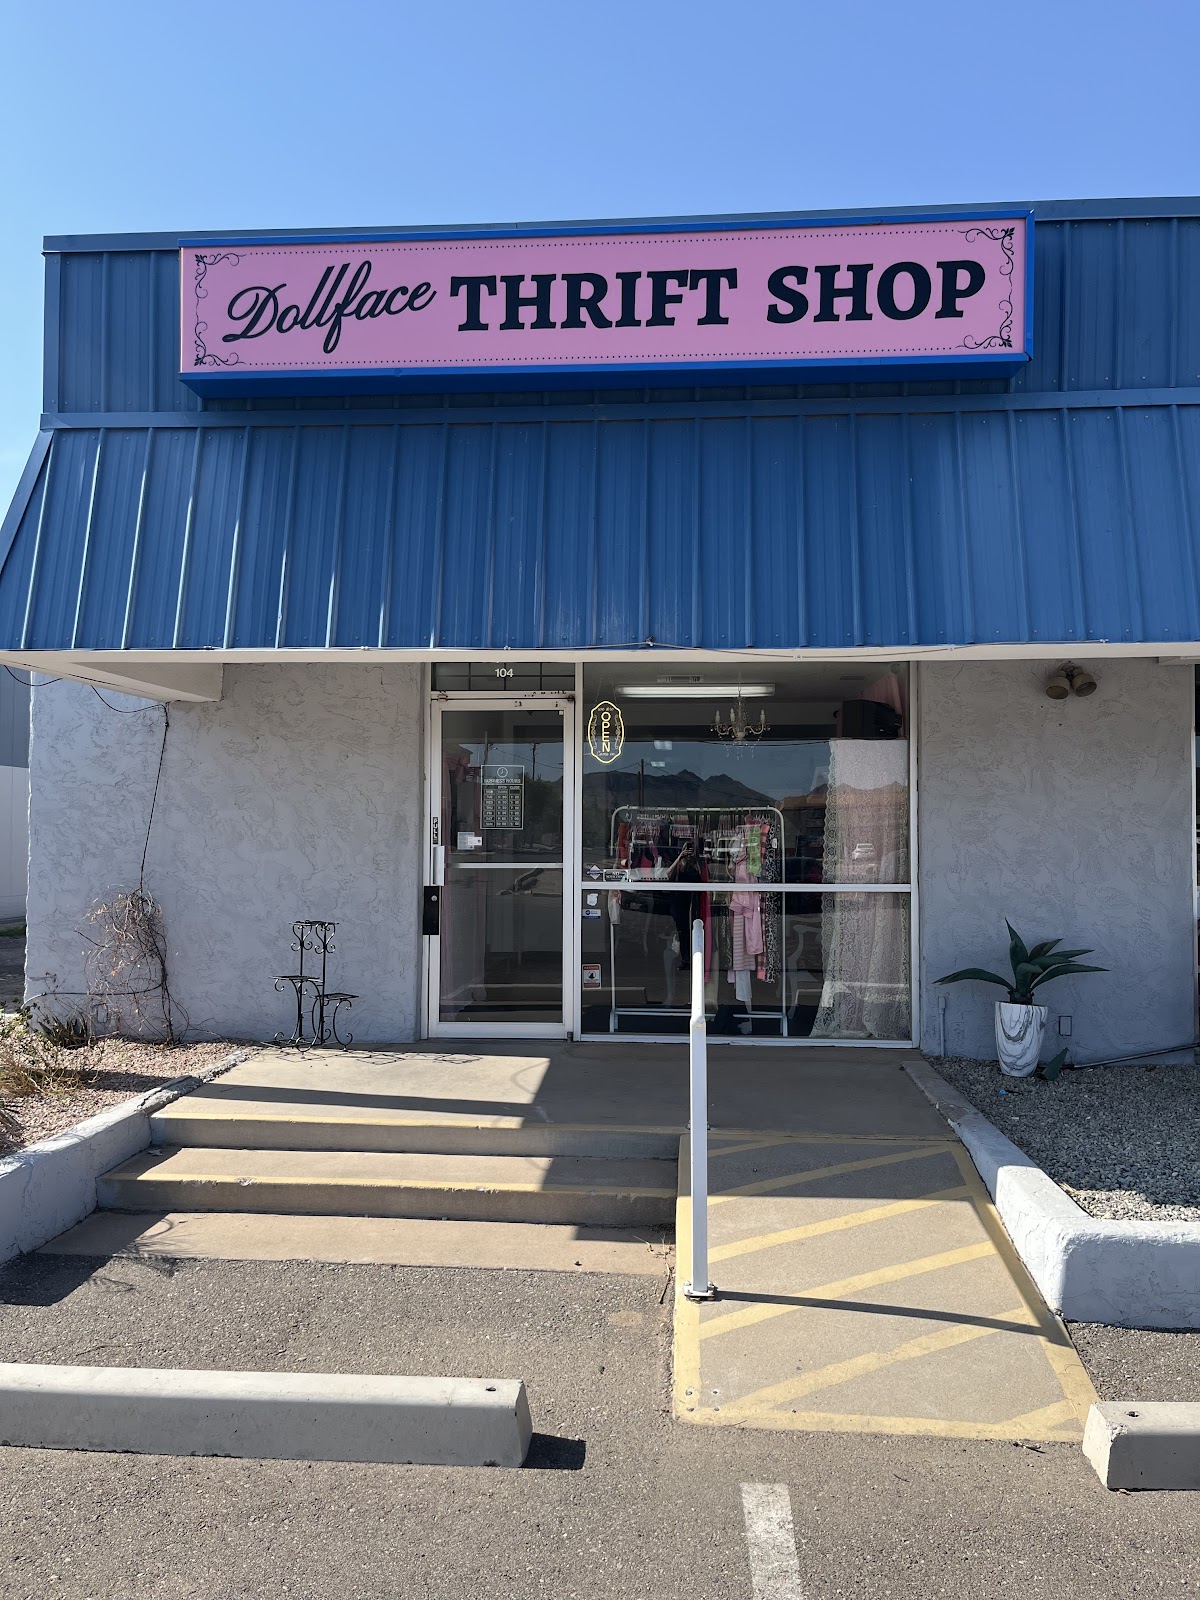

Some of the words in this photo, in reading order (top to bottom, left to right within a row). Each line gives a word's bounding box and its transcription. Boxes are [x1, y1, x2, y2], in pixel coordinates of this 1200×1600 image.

[222, 260, 437, 354] Dollface
[450, 268, 738, 332] THRIFT
[767, 259, 985, 324] SHOP
[495, 668, 514, 678] 104
[601, 711, 611, 752] OPEN
